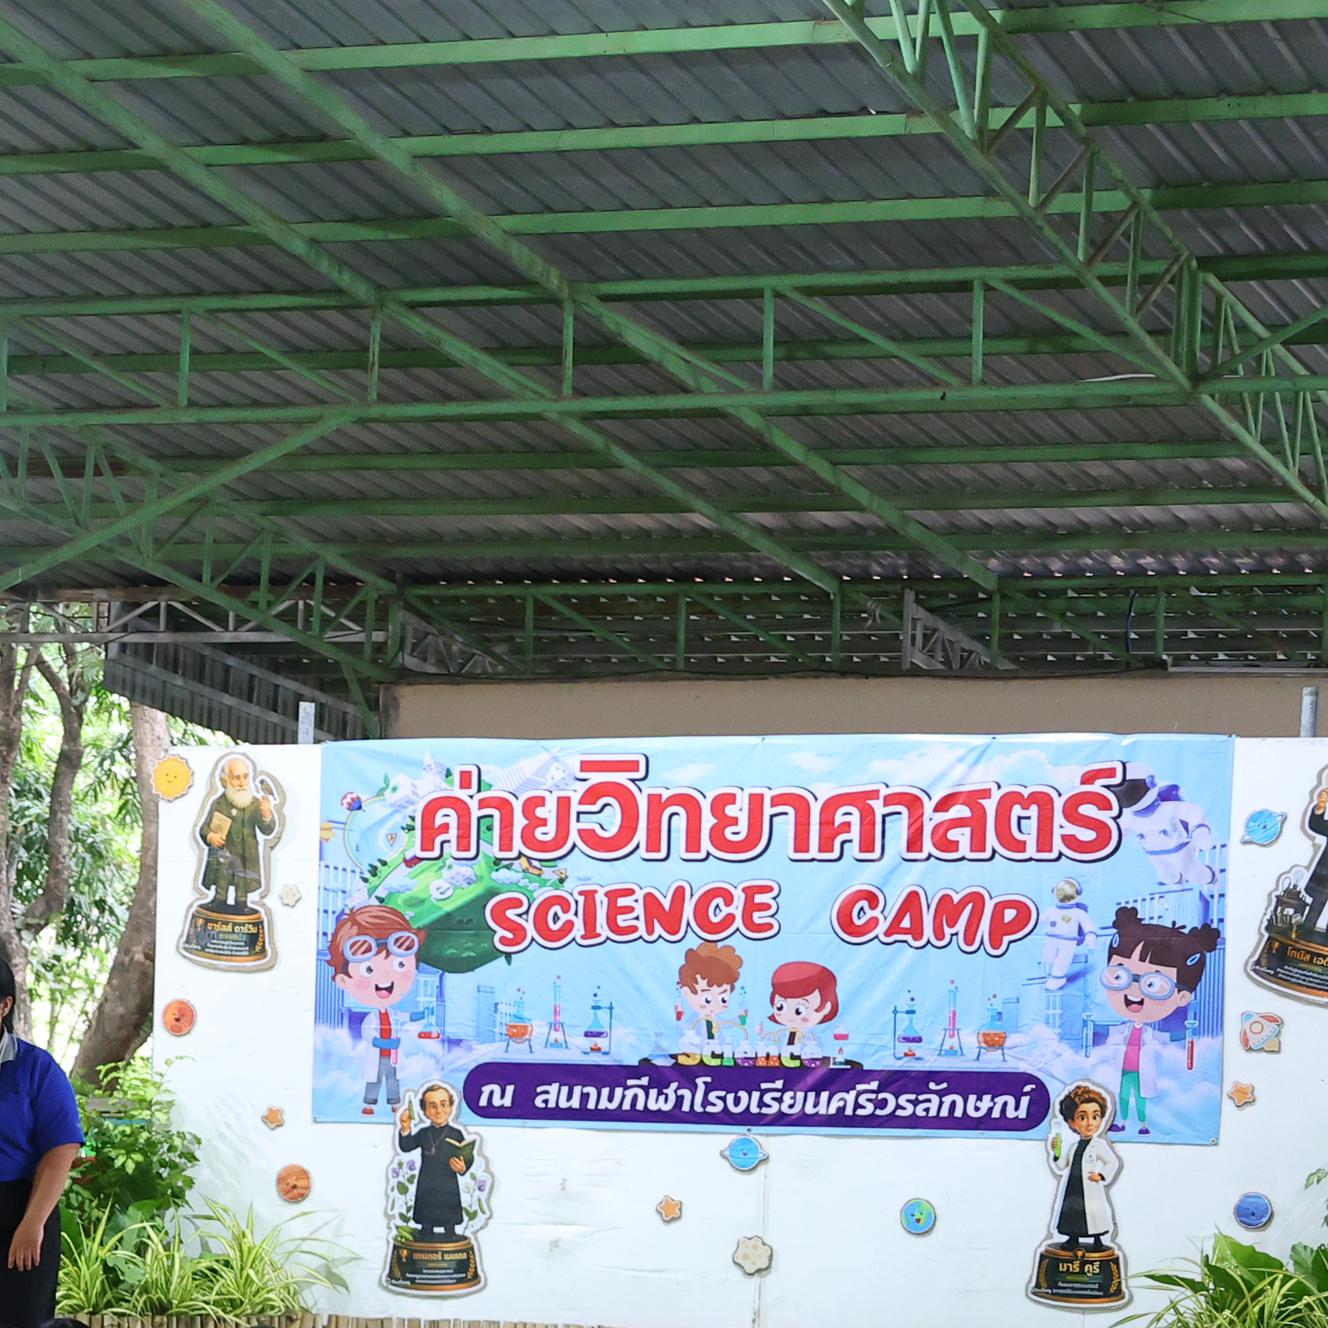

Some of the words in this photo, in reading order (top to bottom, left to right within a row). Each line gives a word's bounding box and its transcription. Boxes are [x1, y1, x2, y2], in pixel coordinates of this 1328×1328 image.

[418, 757, 1119, 856] ค่ายวิทยาศาสตร์
[489, 884, 777, 948] SCIENCE
[835, 888, 1034, 951] CAMP
[478, 1082, 515, 1108] ณ
[533, 1076, 1037, 1119] สนามกีฬาโรงเรียนศรีวรลักษณ์
